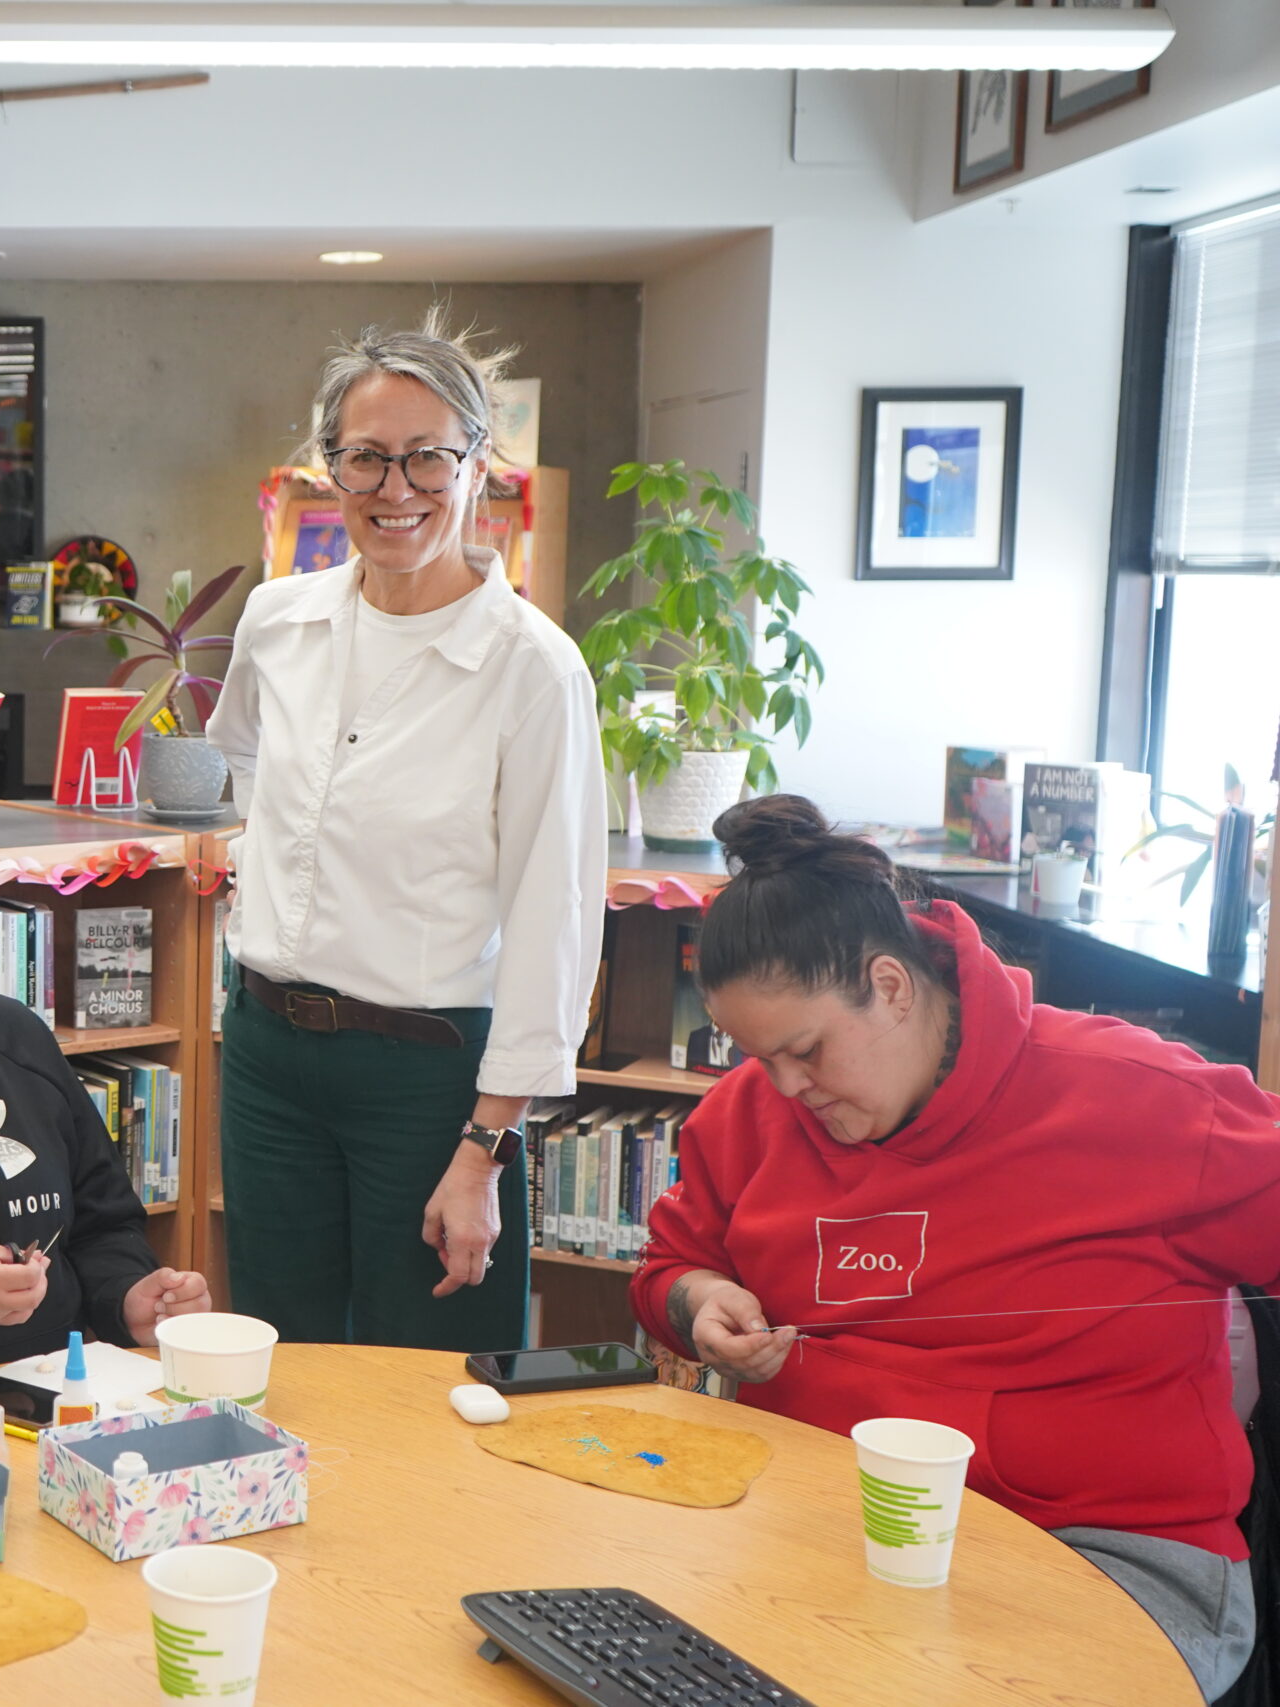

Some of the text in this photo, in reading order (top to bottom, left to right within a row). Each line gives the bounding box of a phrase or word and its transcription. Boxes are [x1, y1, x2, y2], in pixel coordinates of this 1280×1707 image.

[1043, 768, 1062, 784] AM
[1065, 769, 1089, 786] NOT
[1030, 782, 1094, 802] A NUMBER
[88, 989, 144, 1003] A MINOR
[89, 1001, 143, 1015] CHORUS
[837, 1245, 903, 1271] Zoo.
